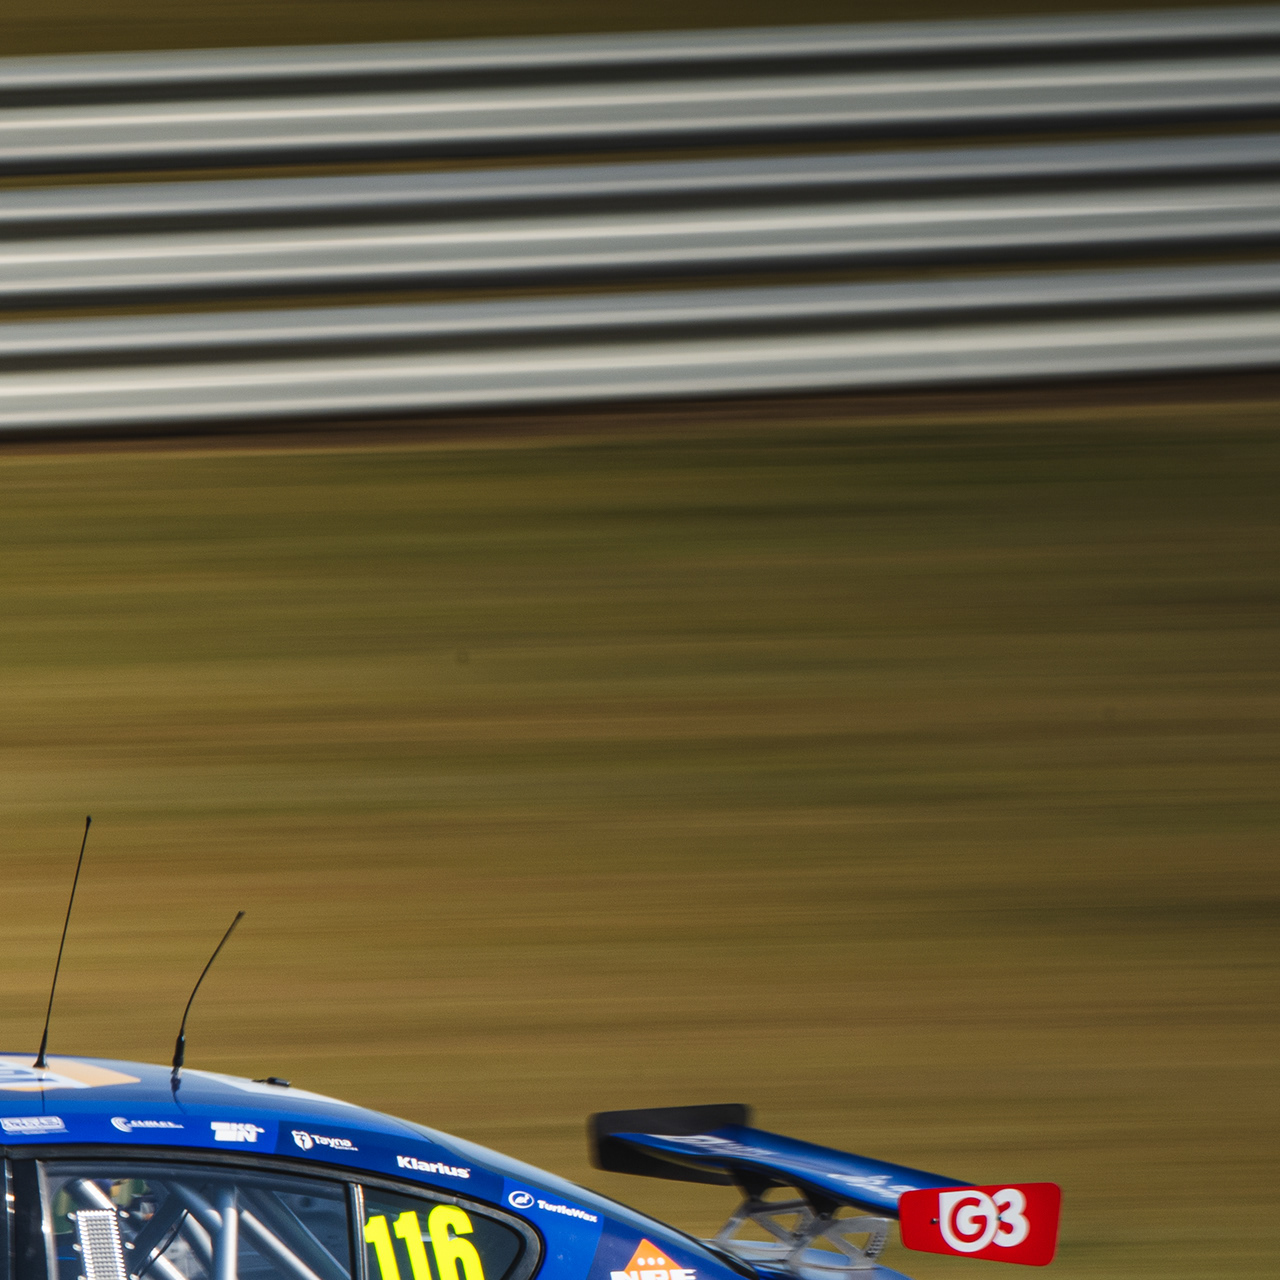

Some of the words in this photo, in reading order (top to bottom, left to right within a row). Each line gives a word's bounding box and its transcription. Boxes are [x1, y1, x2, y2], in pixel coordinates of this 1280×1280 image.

[311, 1134, 352, 1148] Tayna
[396, 1155, 470, 1179] Klarius
[940, 1188, 1029, 1252] G3
